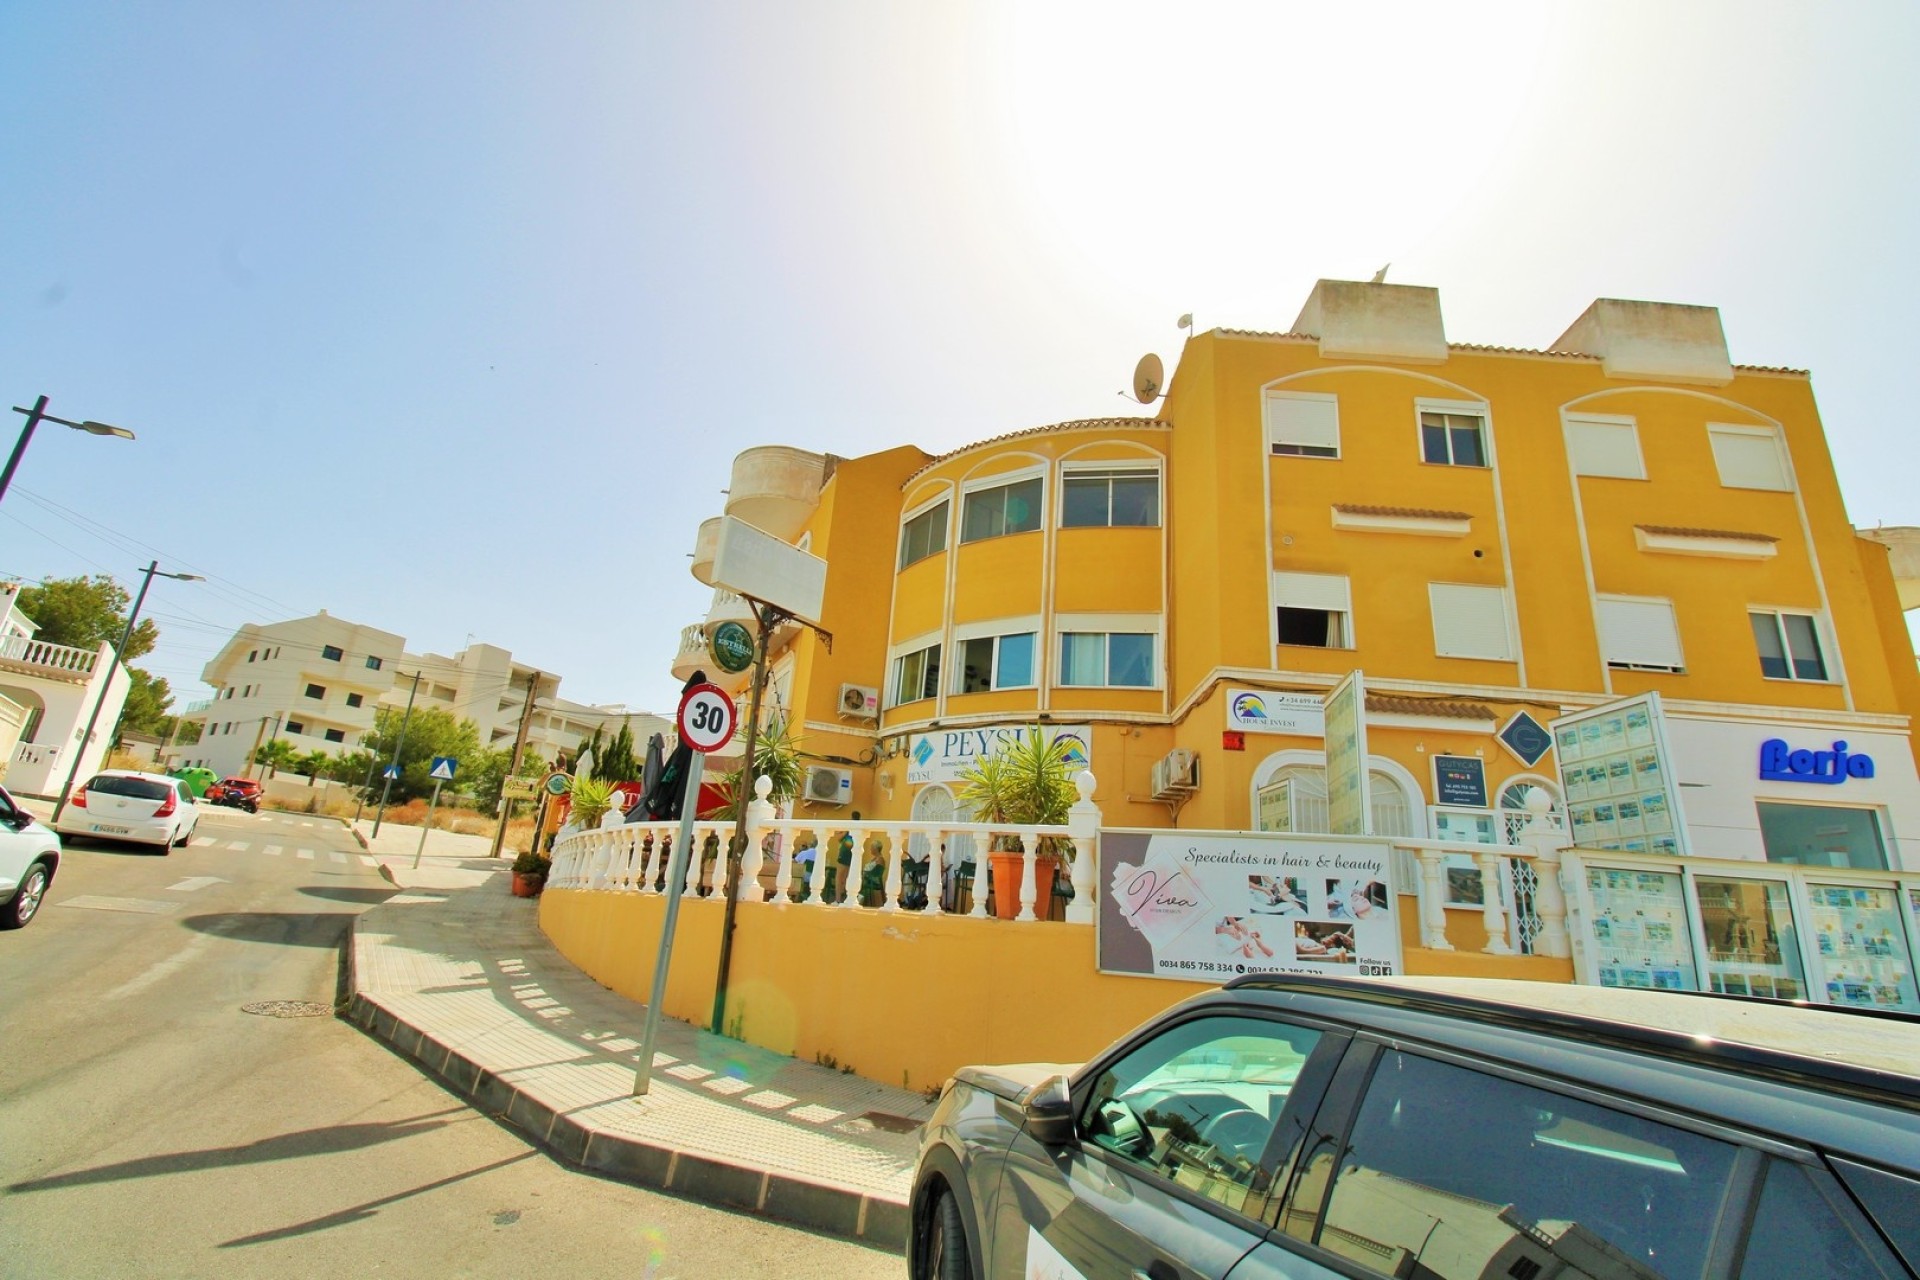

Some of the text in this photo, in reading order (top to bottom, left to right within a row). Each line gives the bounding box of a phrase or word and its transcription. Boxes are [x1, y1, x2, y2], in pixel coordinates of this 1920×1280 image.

[692, 701, 724, 734] 30
[1270, 719, 1296, 728] INVEST
[943, 728, 1039, 757] PEYSU
[1439, 760, 1479, 769] GUTYCAS
[1759, 738, 1874, 785] Borja
[1184, 847, 1384, 875] Specialists in hair & beauty
[1128, 870, 1198, 917] Viva
[1159, 960, 1178, 968] 0034
[1180, 960, 1196, 969] 865
[1198, 962, 1215, 971] 758
[1216, 963, 1233, 972] 334
[1247, 966, 1267, 974] 0034
[1360, 957, 1382, 965] Follow
